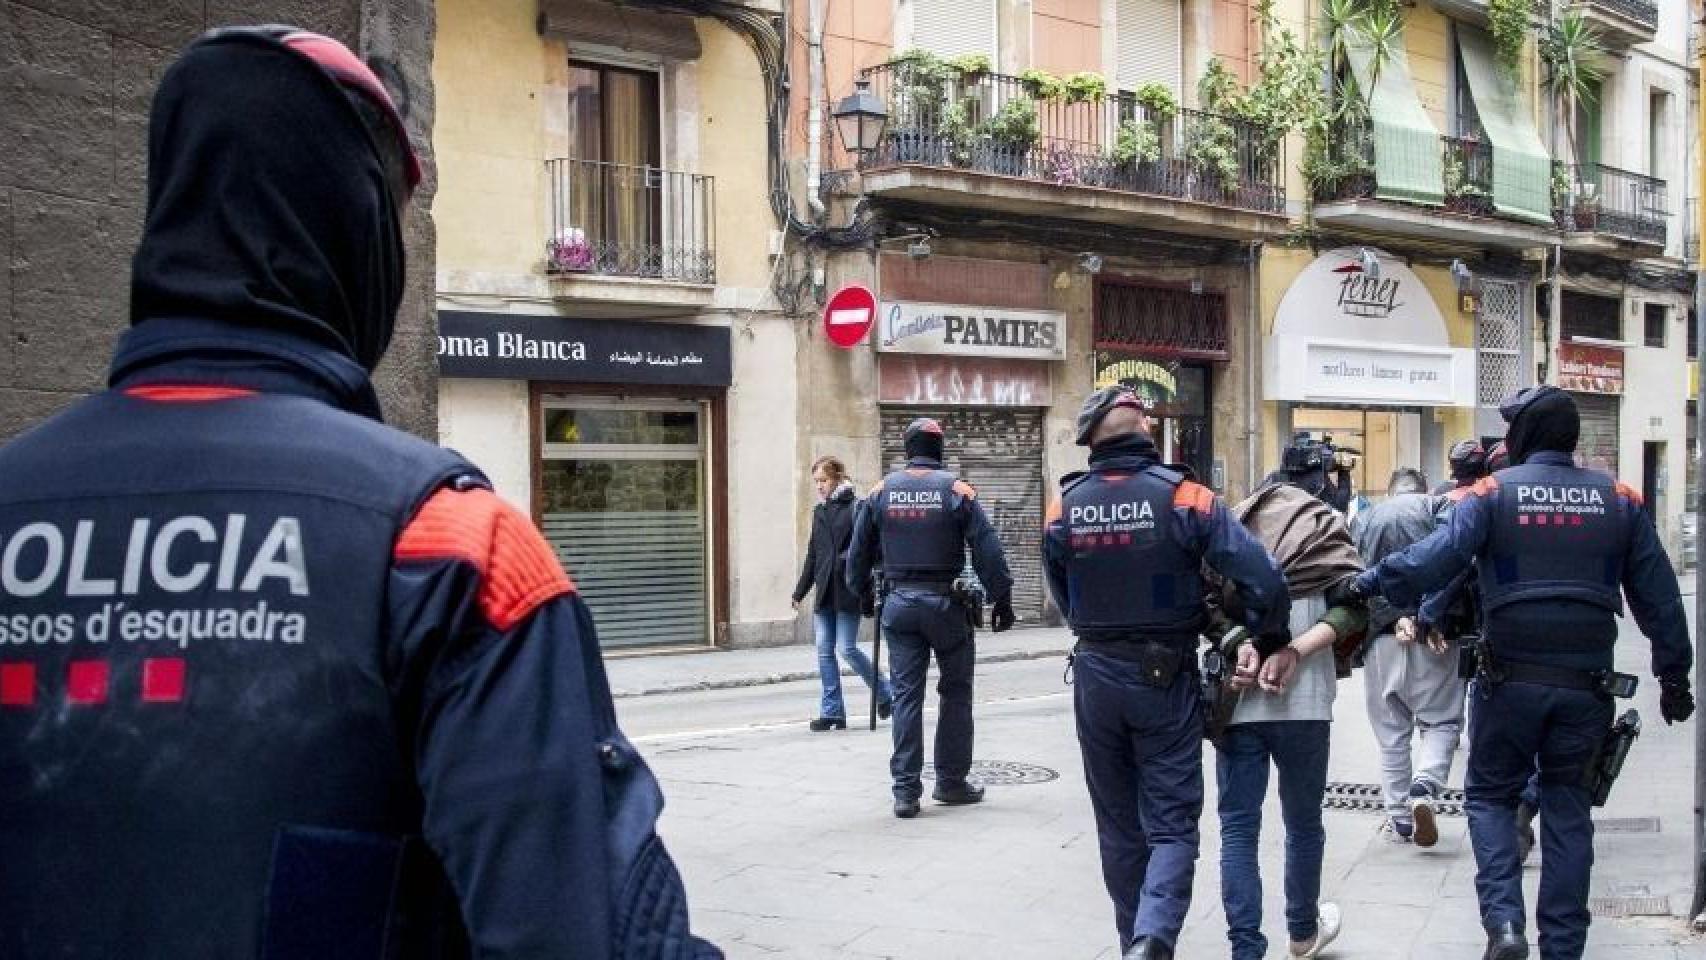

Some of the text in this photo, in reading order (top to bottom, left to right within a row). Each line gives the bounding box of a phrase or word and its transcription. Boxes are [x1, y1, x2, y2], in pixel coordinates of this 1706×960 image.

[497, 331, 587, 361] Blanca
[943, 315, 1058, 349] PAMIES
[889, 491, 943, 503] POLICIA
[1517, 485, 1605, 505] POLICIA
[1070, 499, 1154, 525] POLICIA
[0, 513, 310, 597] OLICIA
